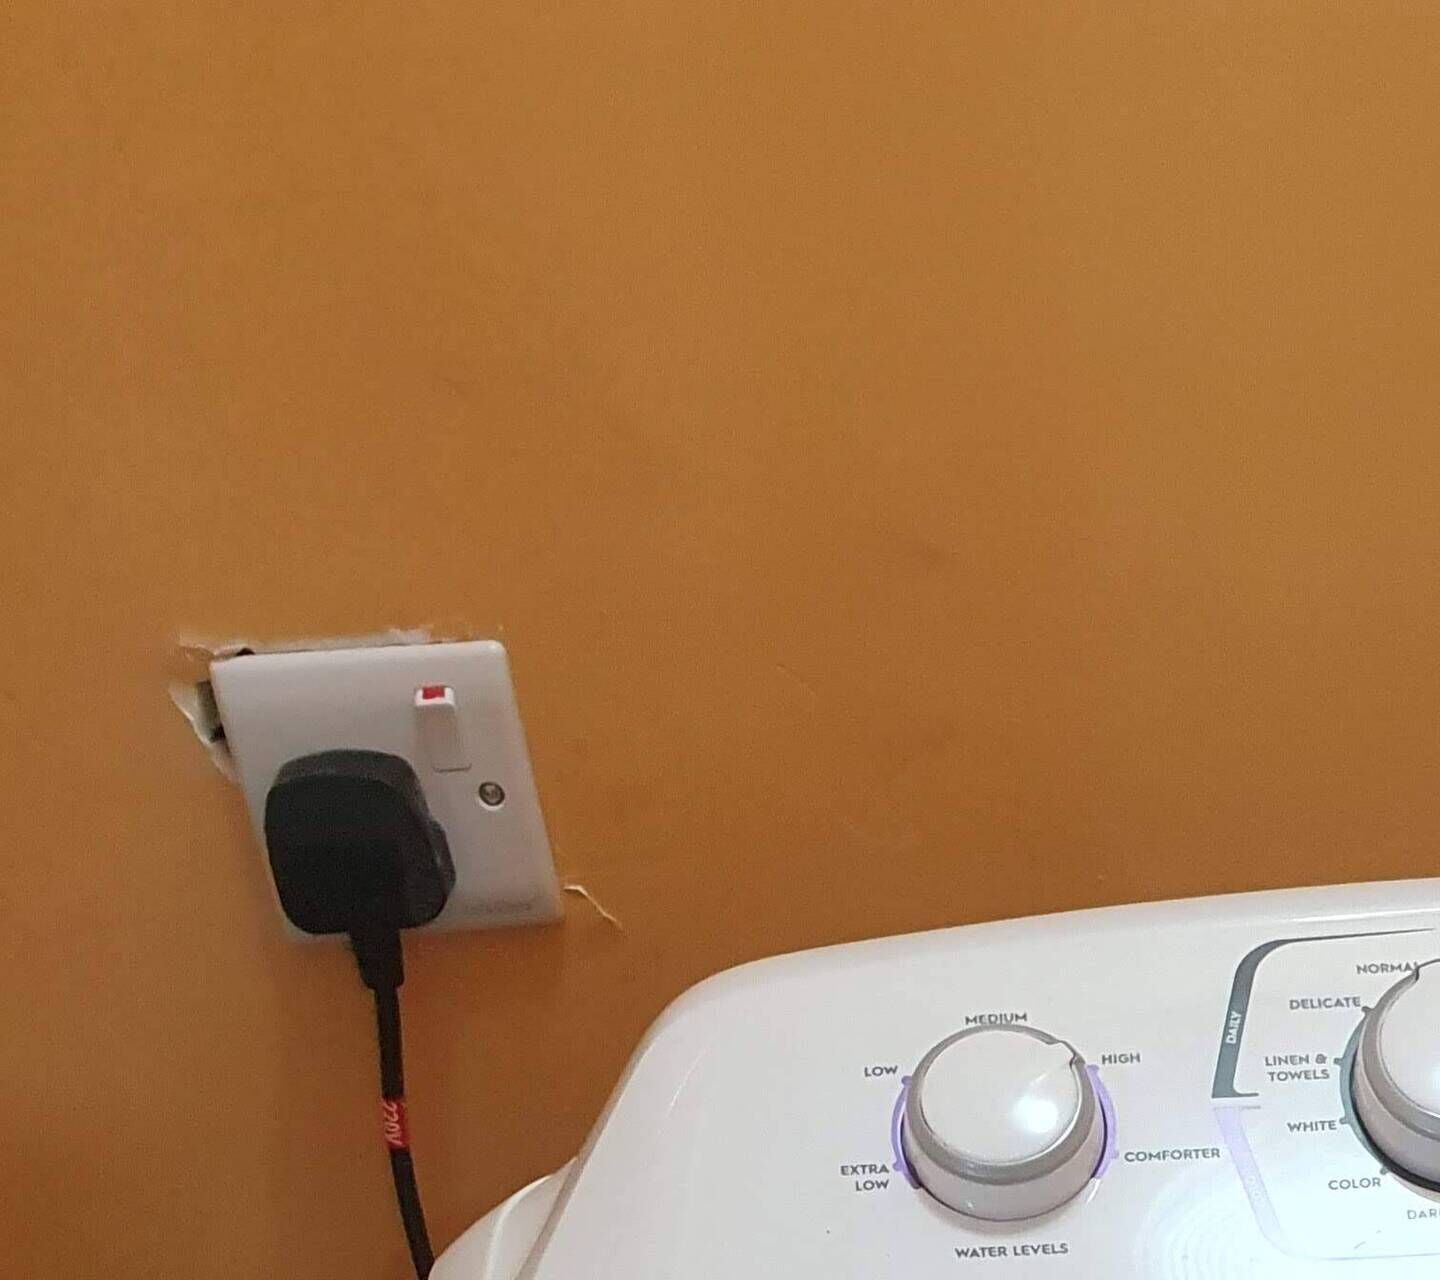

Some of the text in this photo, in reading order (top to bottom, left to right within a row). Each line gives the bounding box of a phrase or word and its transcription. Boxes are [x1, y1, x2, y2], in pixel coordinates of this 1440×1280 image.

[1356, 961, 1418, 975] NORMA
[1289, 996, 1361, 1010] DELICATE
[965, 1012, 1028, 1026] MEDIUM
[1225, 1011, 1242, 1045] DAILY
[1101, 1052, 1141, 1065] HIGH
[1265, 1053, 1327, 1067] LINEN &
[864, 1065, 898, 1078] LOW
[1268, 1069, 1330, 1082] TOWELS
[1288, 1119, 1337, 1133] WHITE
[1124, 1147, 1221, 1163] COMFORTER
[841, 1163, 889, 1177] EXTRA
[855, 1179, 889, 1191] LOW
[1328, 1177, 1381, 1191] COLOR
[954, 1242, 1069, 1259] WATER LEVELS
